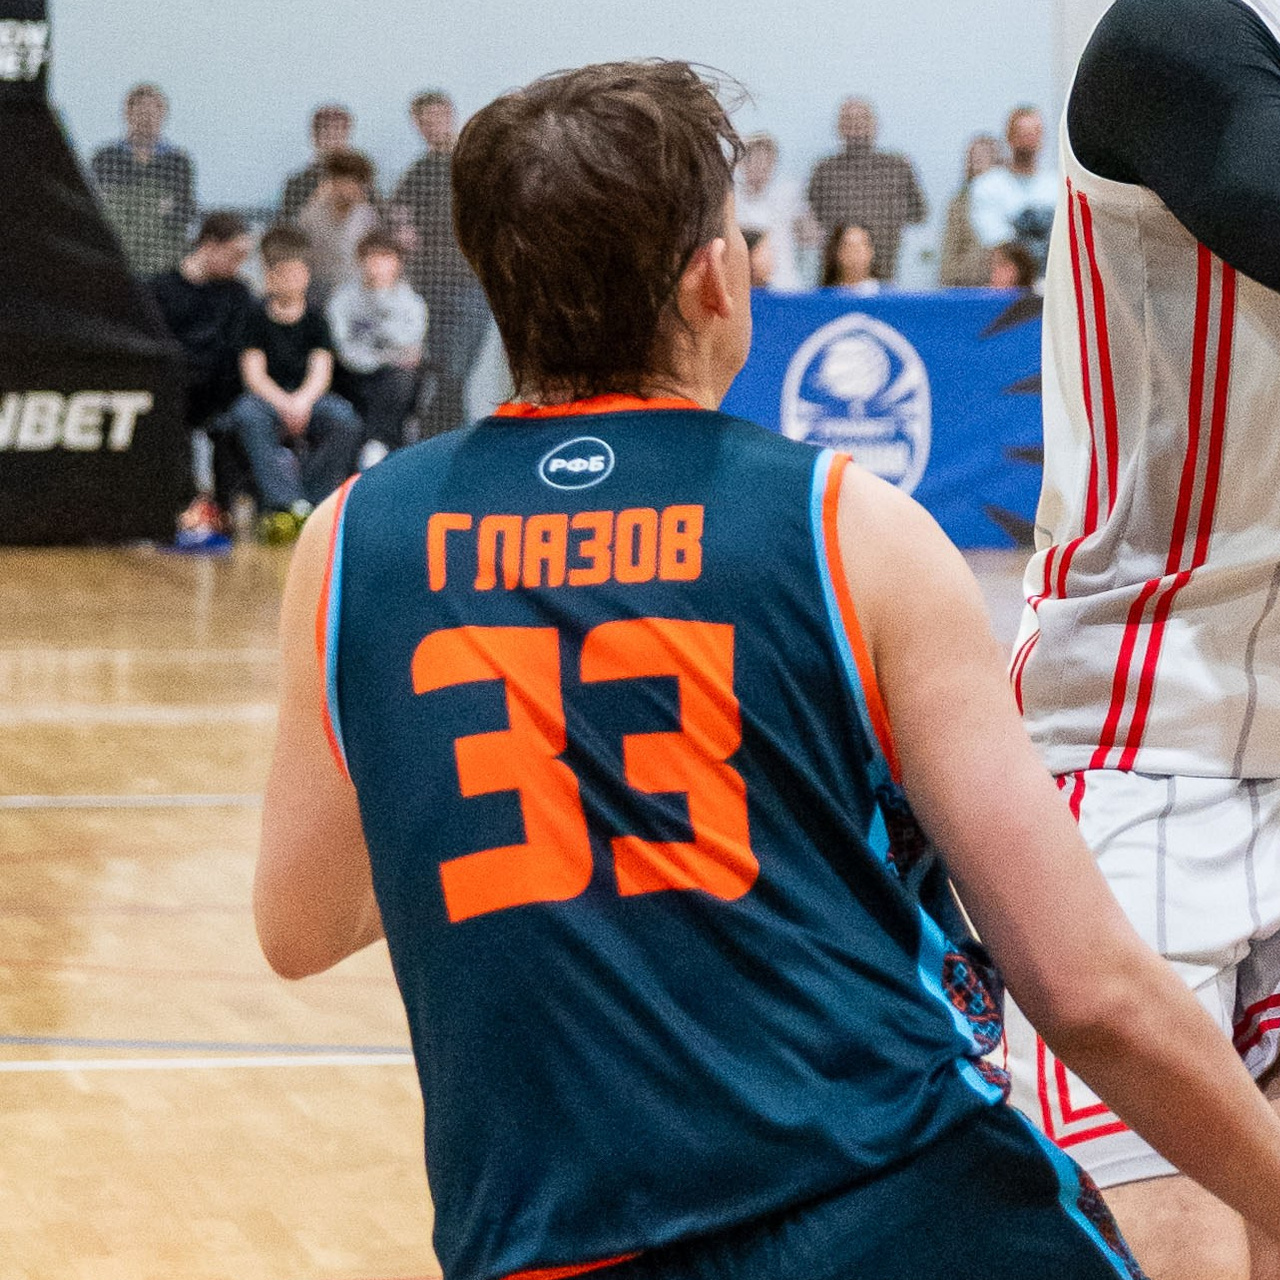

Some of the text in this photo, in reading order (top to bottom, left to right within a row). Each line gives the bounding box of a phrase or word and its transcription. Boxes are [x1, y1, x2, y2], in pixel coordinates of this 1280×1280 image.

[549, 455, 605, 473] РФБ
[427, 504, 704, 592] ГЛАЗОВ
[411, 617, 760, 924] 33
